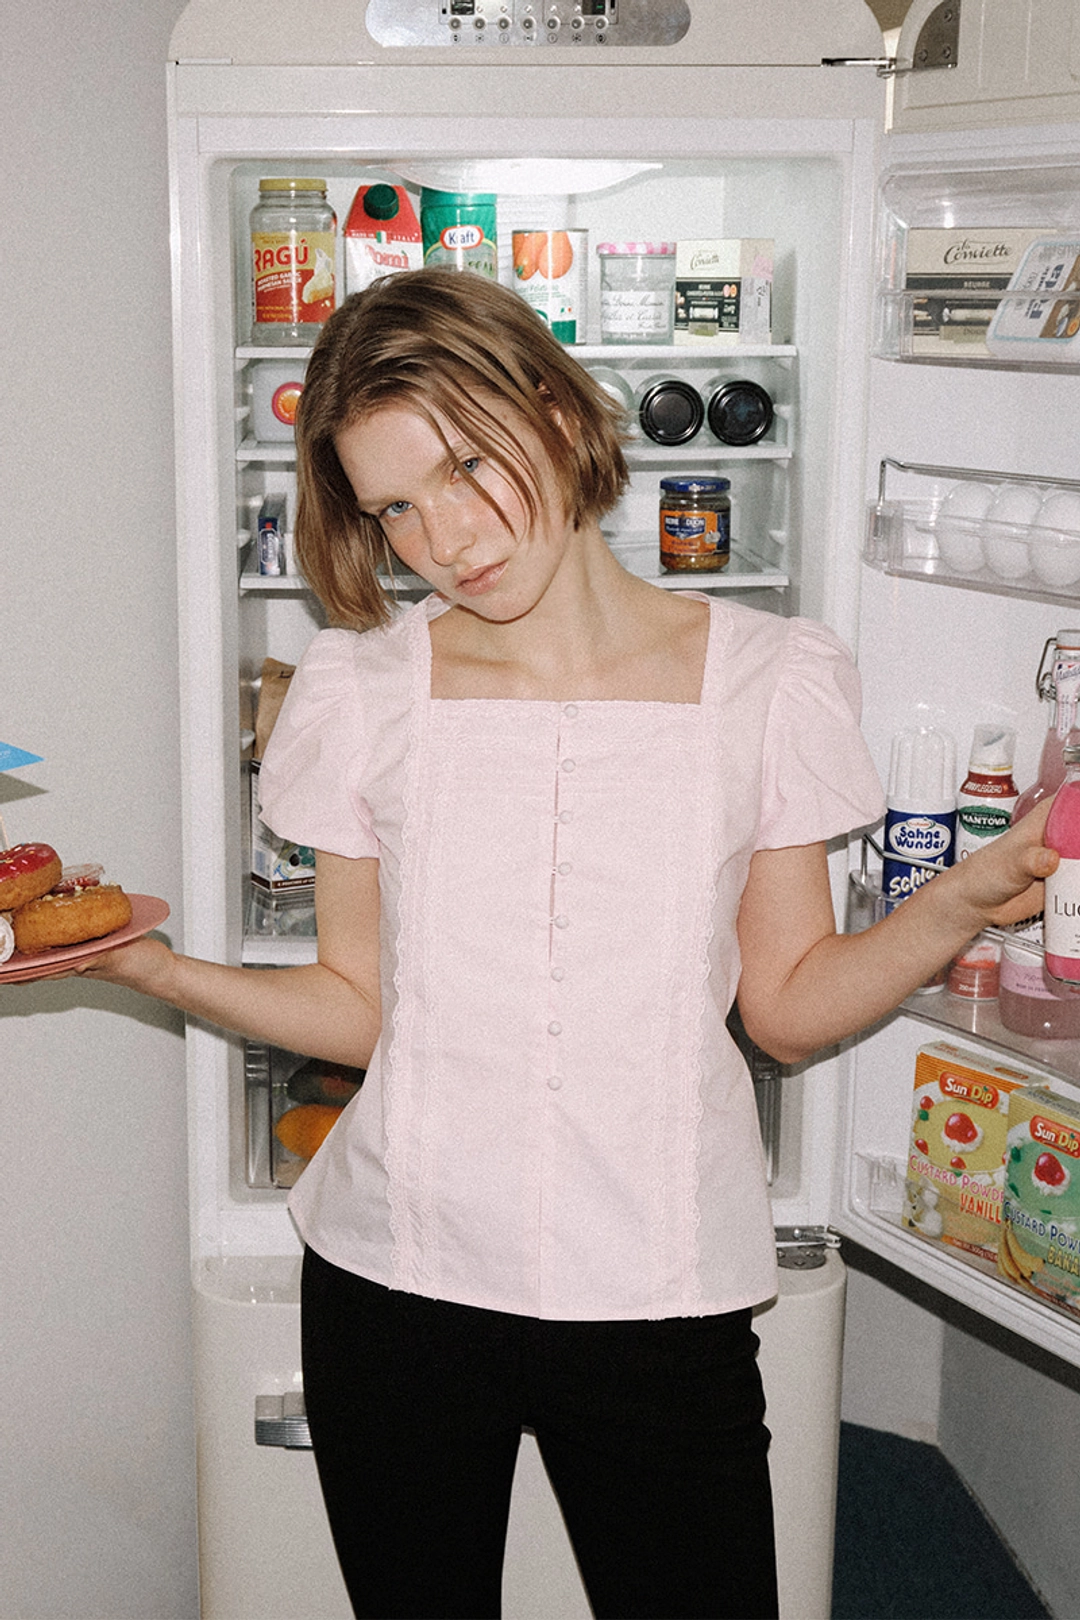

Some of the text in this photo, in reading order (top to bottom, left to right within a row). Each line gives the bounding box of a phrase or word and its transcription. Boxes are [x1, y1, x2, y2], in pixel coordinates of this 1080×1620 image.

[449, 229, 475, 244] Kaft
[1029, 264, 1065, 319] Fta
[899, 826, 941, 840] Sahne
[961, 813, 1007, 826] MANTOVA
[894, 835, 946, 850] Wunder
[944, 1077, 994, 1105] Sun Dip
[1034, 1121, 1079, 1153] Sun Dip
[908, 1154, 958, 1187] CUSTARD
[1003, 1201, 1047, 1238] CUSTARD
[1049, 1224, 1080, 1254] POW
